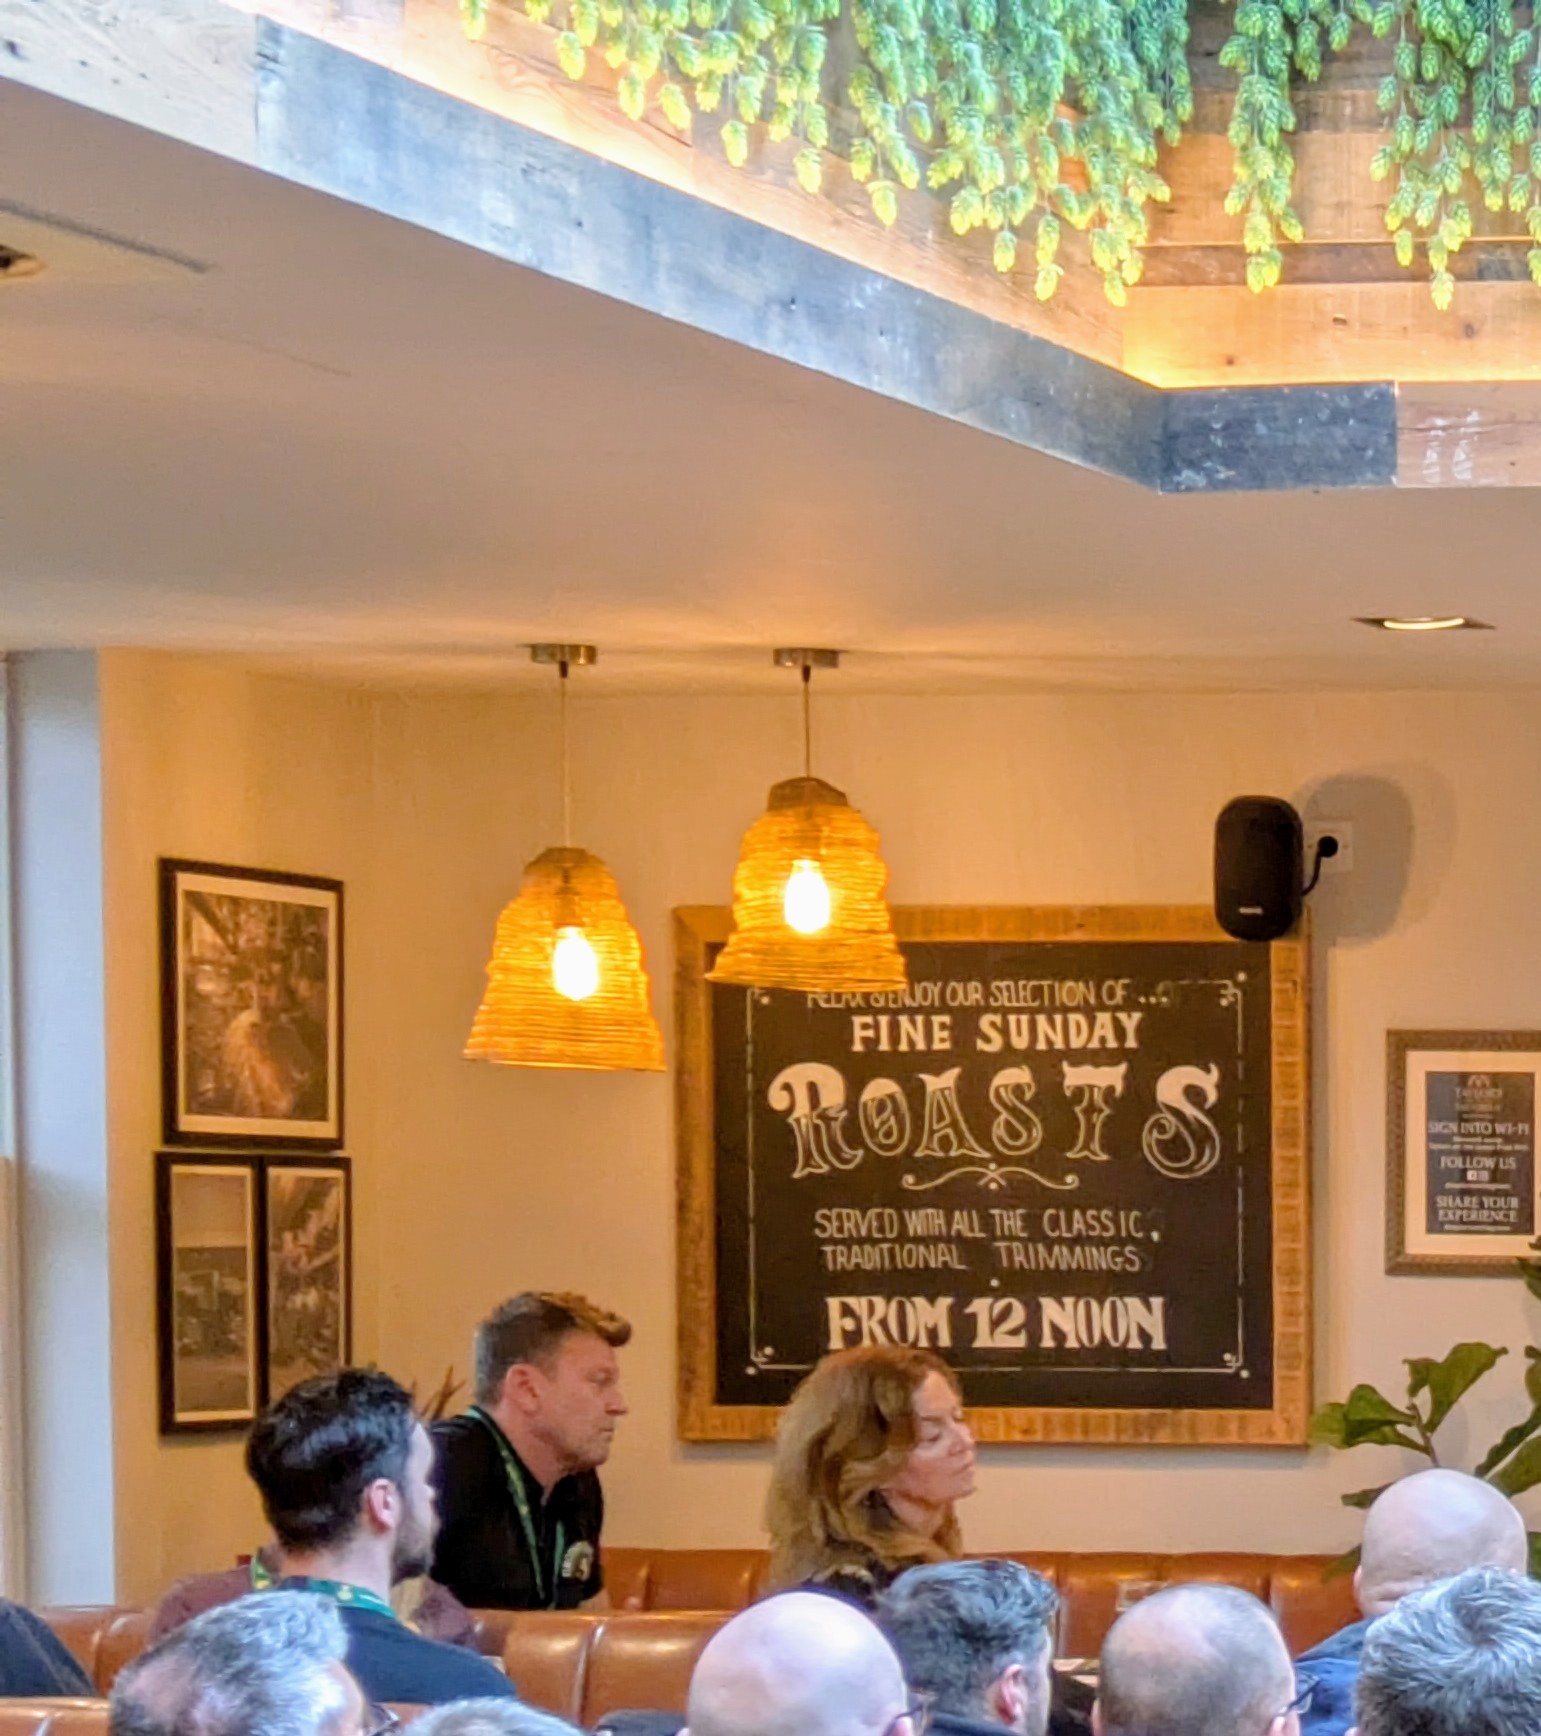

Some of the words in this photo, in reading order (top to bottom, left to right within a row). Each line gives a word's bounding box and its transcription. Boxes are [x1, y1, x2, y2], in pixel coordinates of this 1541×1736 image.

[946, 979, 982, 1008] OUR
[990, 978, 1095, 1008] SELECTION
[1102, 979, 1131, 1007] OF
[850, 1014, 953, 1052] FINE
[976, 1011, 1143, 1051] SUNDAY
[767, 1060, 1221, 1180] ROASTS
[1461, 1122, 1492, 1135] INTO
[1440, 1156, 1496, 1169] FOLLOW
[1499, 1157, 1516, 1169] US
[1436, 1195, 1479, 1208] SHARE
[1481, 1196, 1519, 1208] YOUR
[1438, 1209, 1517, 1222] EXPERIENCE
[814, 1208, 898, 1239] SERVED
[903, 1210, 947, 1238] WITH
[950, 1208, 987, 1238] ALL
[989, 1208, 1028, 1238] THE
[821, 1244, 970, 1271] TRADITIONAL
[992, 1241, 1141, 1271] TRIMMINGS
[825, 1296, 955, 1350] FROM
[963, 1297, 1028, 1348] 12
[1037, 1296, 1167, 1350] NOON
